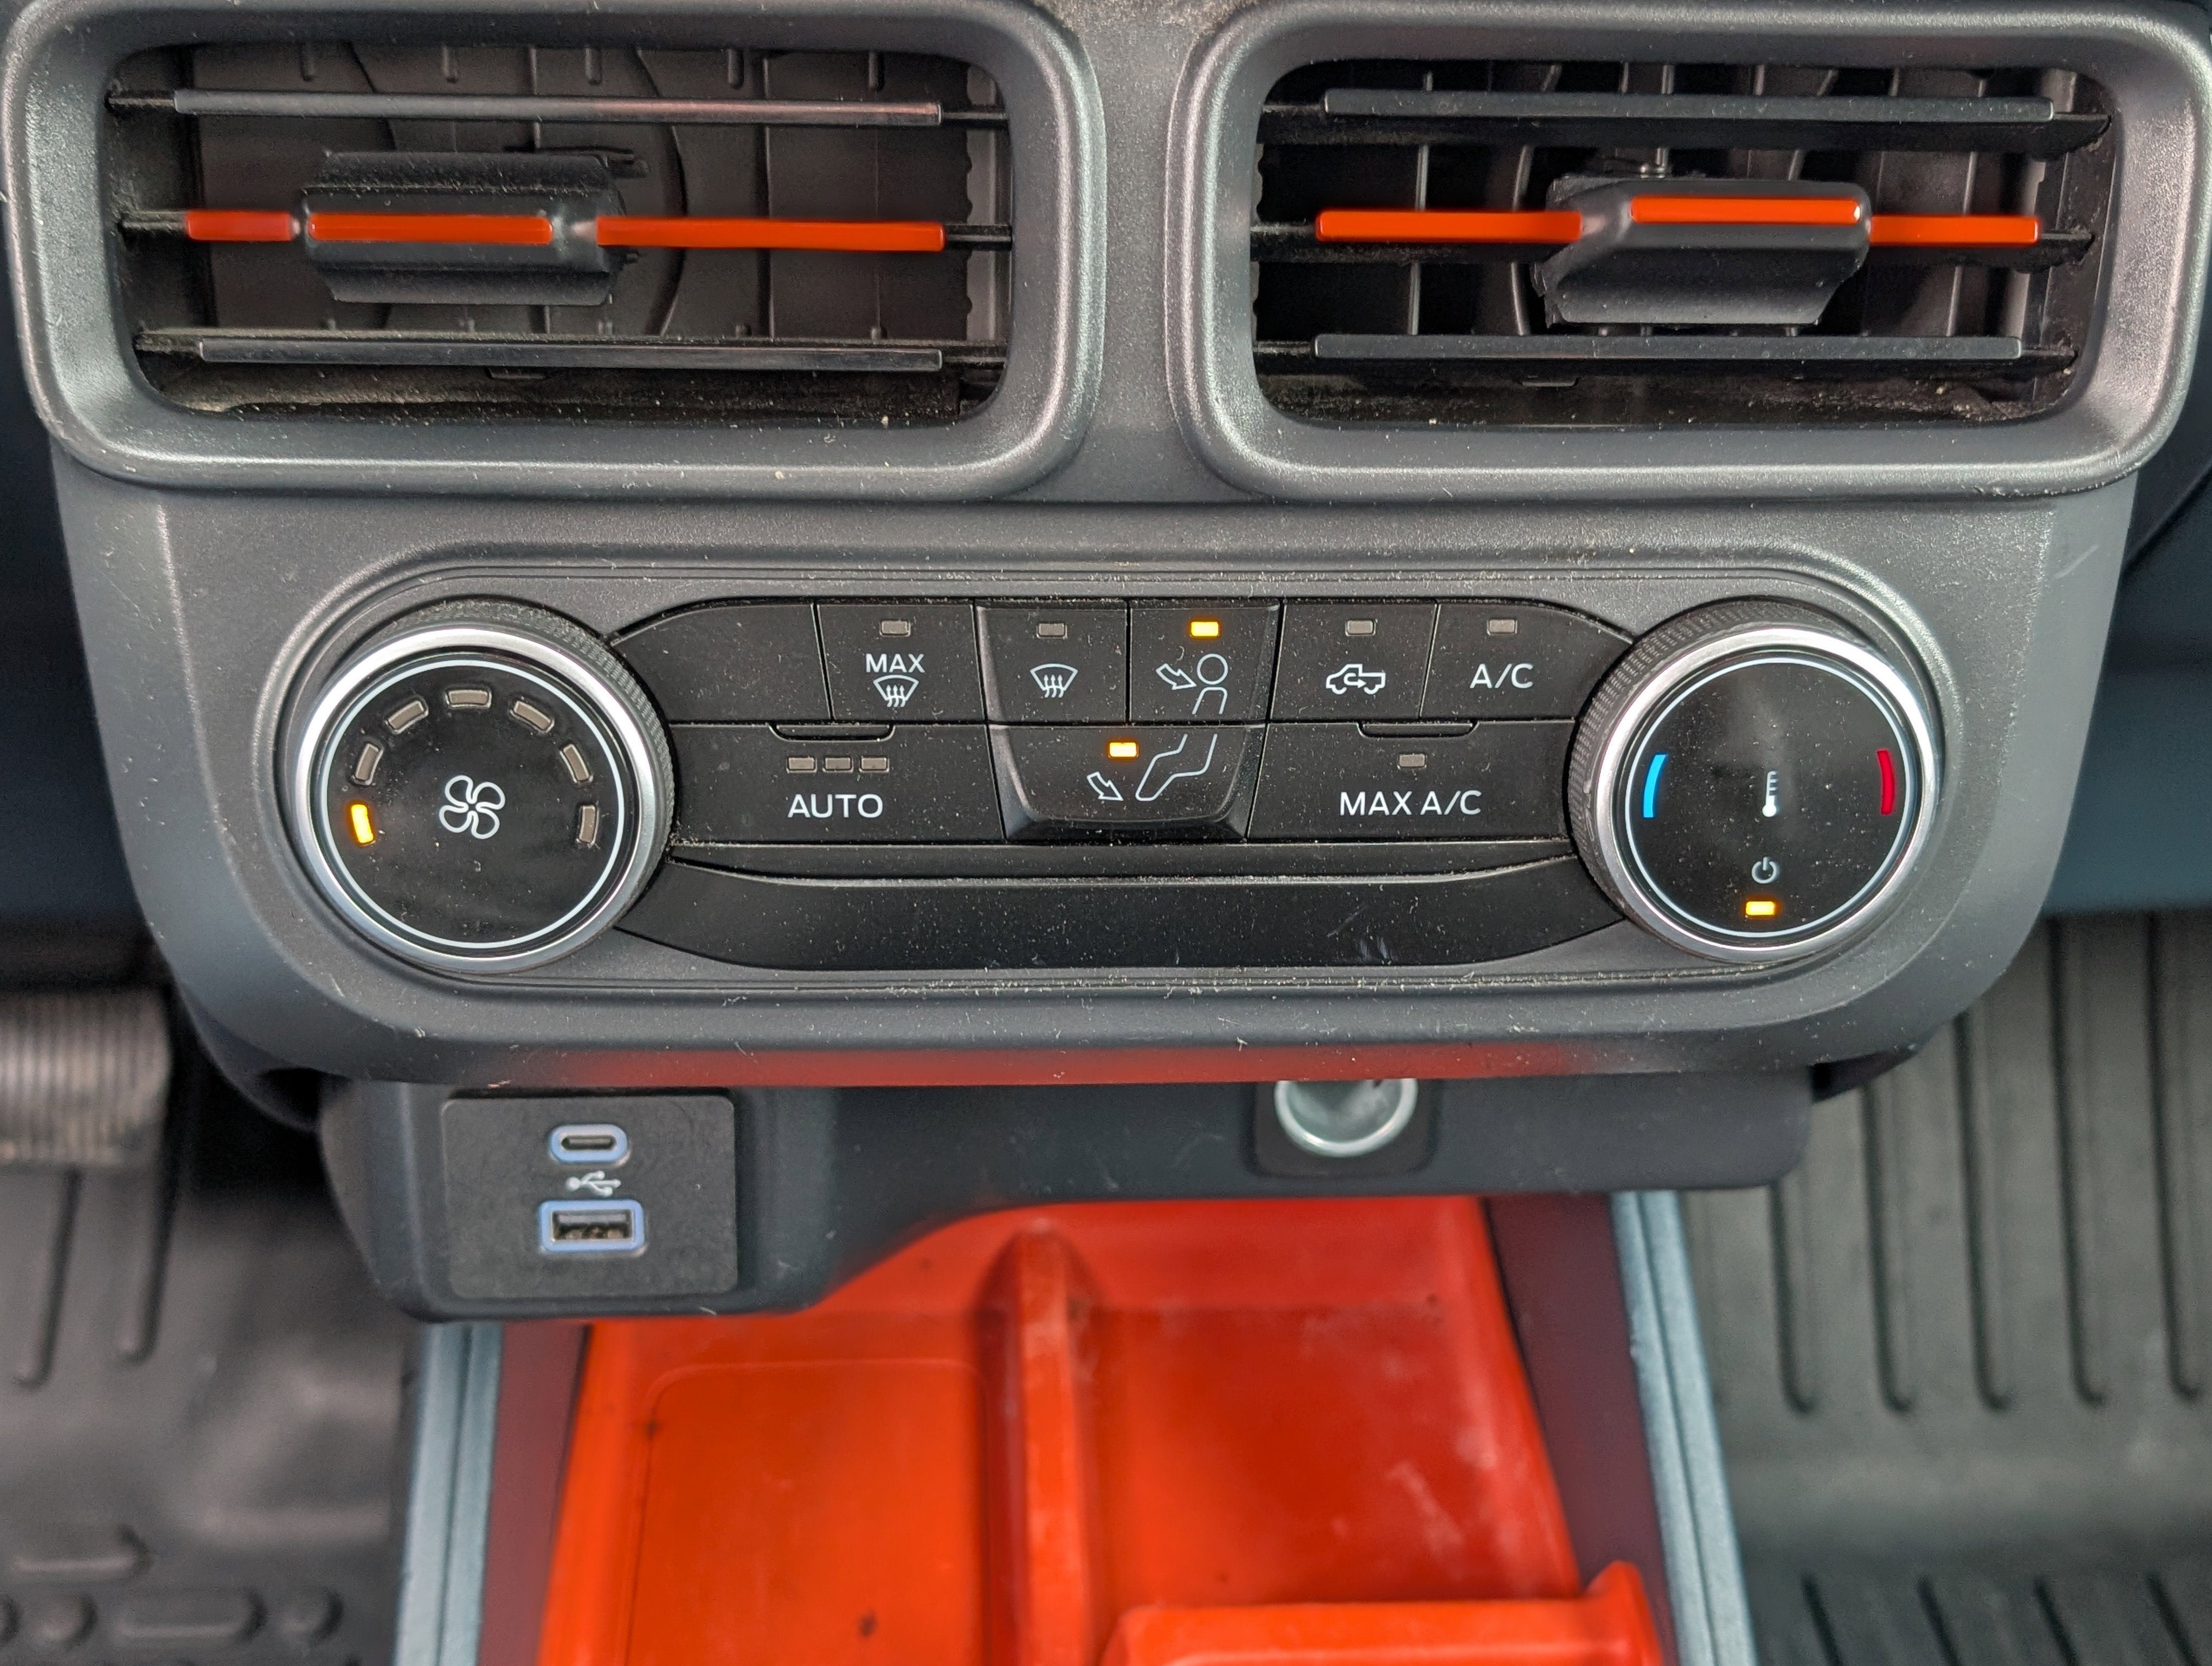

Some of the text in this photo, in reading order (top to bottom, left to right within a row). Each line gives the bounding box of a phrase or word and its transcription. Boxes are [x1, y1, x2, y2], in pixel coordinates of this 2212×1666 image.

[865, 653, 926, 674] MAX
[1469, 663, 1534, 689] A/C
[787, 793, 884, 818] AUTO
[1340, 790, 1482, 816] MAX A/C
